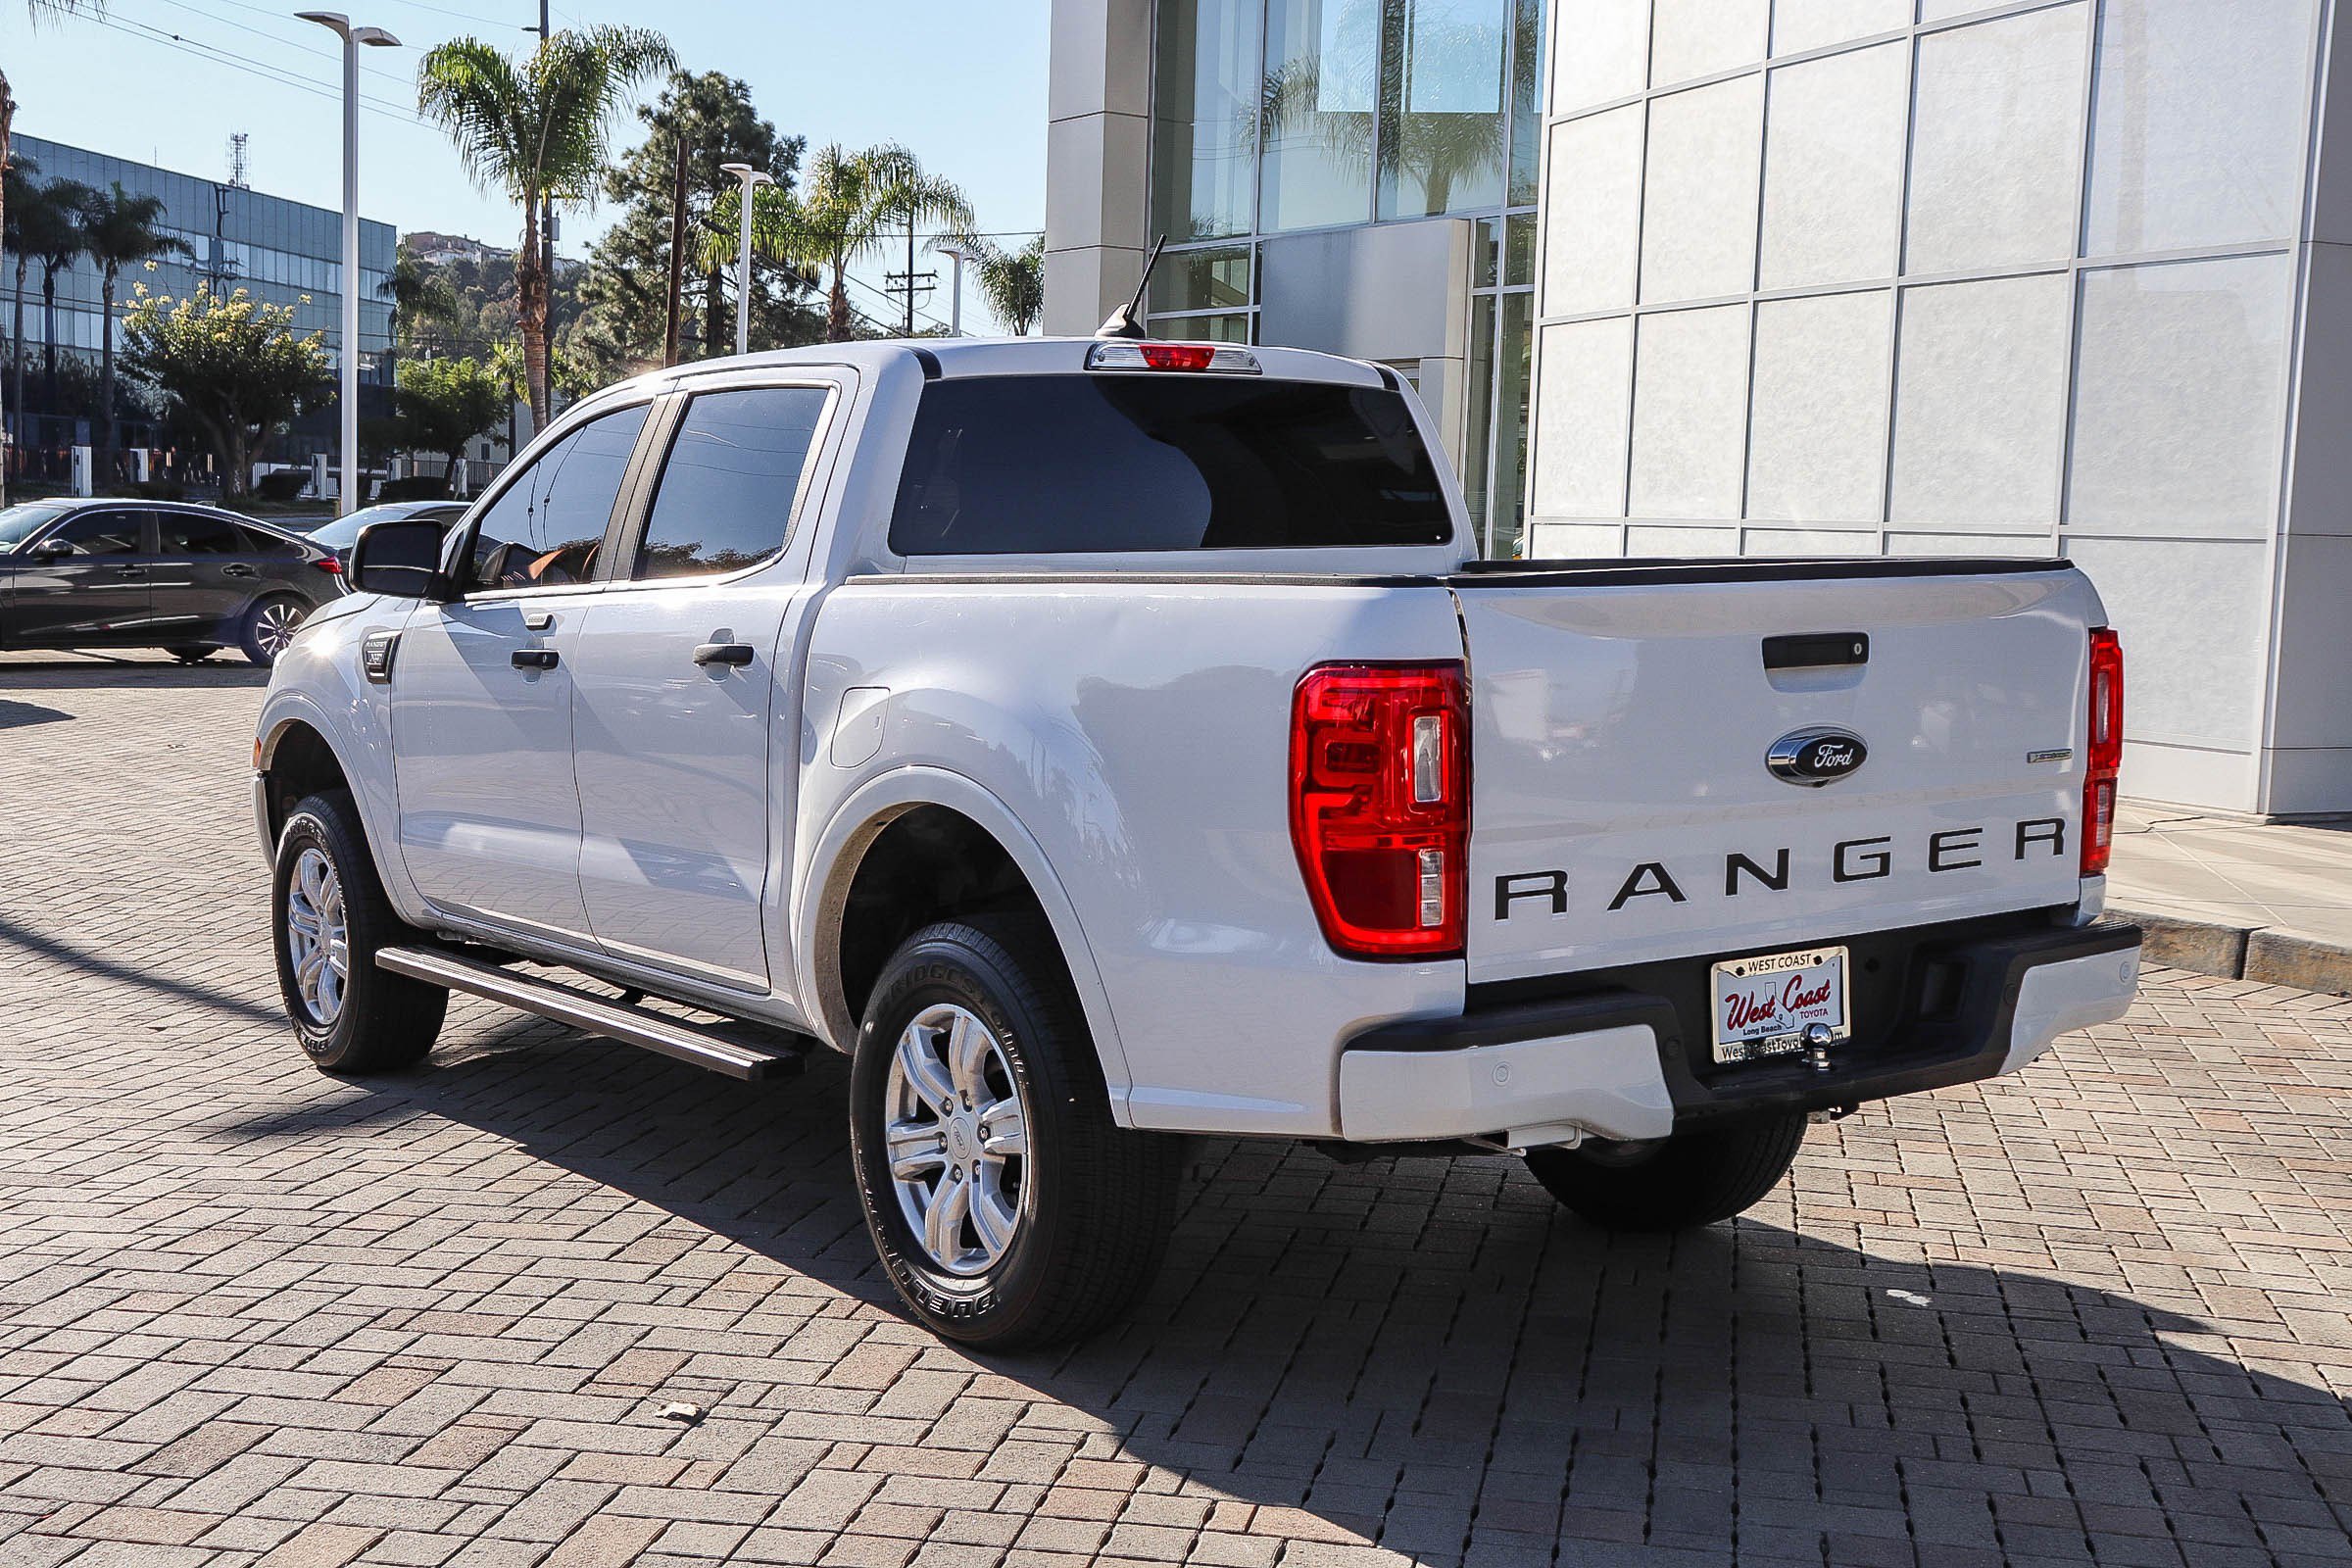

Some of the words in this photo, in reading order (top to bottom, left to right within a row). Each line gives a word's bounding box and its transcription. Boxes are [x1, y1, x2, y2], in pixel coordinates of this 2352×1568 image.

[1814, 744, 1854, 768] Ford
[1494, 816, 2067, 920] RANGER
[1748, 958, 1776, 973] WEST
[1778, 954, 1812, 969] COAST
[1725, 991, 1776, 1030] West
[1783, 974, 1831, 1012] Coast
[1799, 1008, 1829, 1019] TOYOTA
[1742, 1026, 1760, 1036] Long
[1761, 1023, 1783, 1034] Beach
